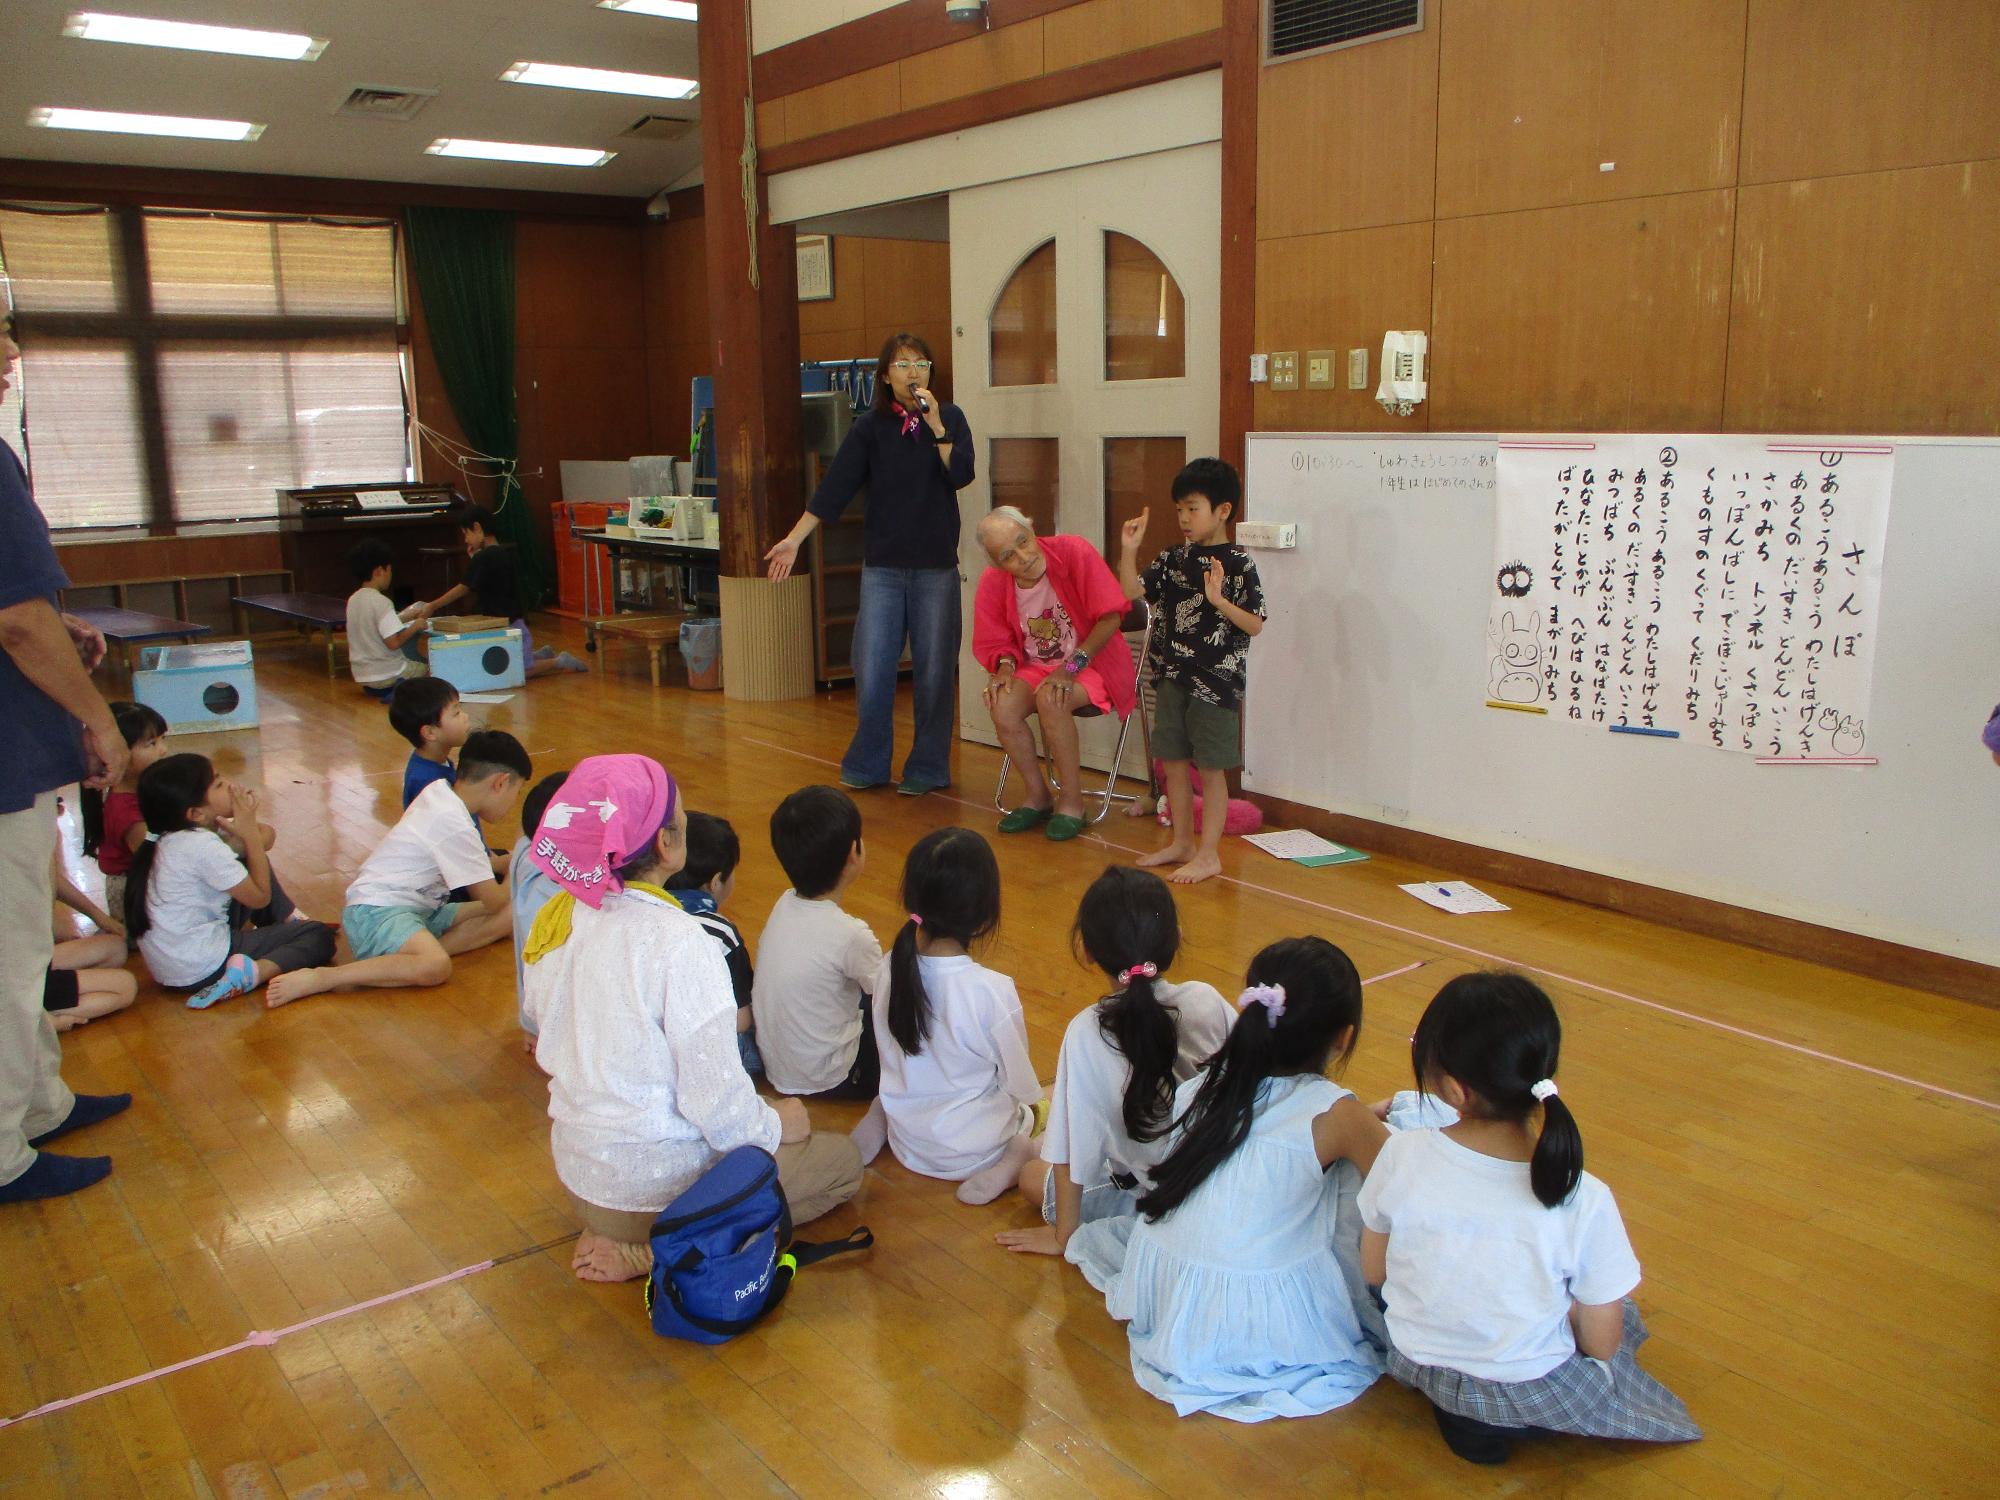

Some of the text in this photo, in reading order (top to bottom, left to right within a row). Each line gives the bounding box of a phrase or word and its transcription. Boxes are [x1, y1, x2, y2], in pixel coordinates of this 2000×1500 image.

[1604, 468, 1624, 541] みつばち
[1755, 471, 1778, 562] さかみち
[1747, 582, 1767, 650] トンネル
[1834, 542, 1865, 658] さんぽ
[1545, 605, 1564, 701] まがりみち
[1686, 636, 1704, 720] くだりみち
[536, 837, 609, 889] 手話ができ
